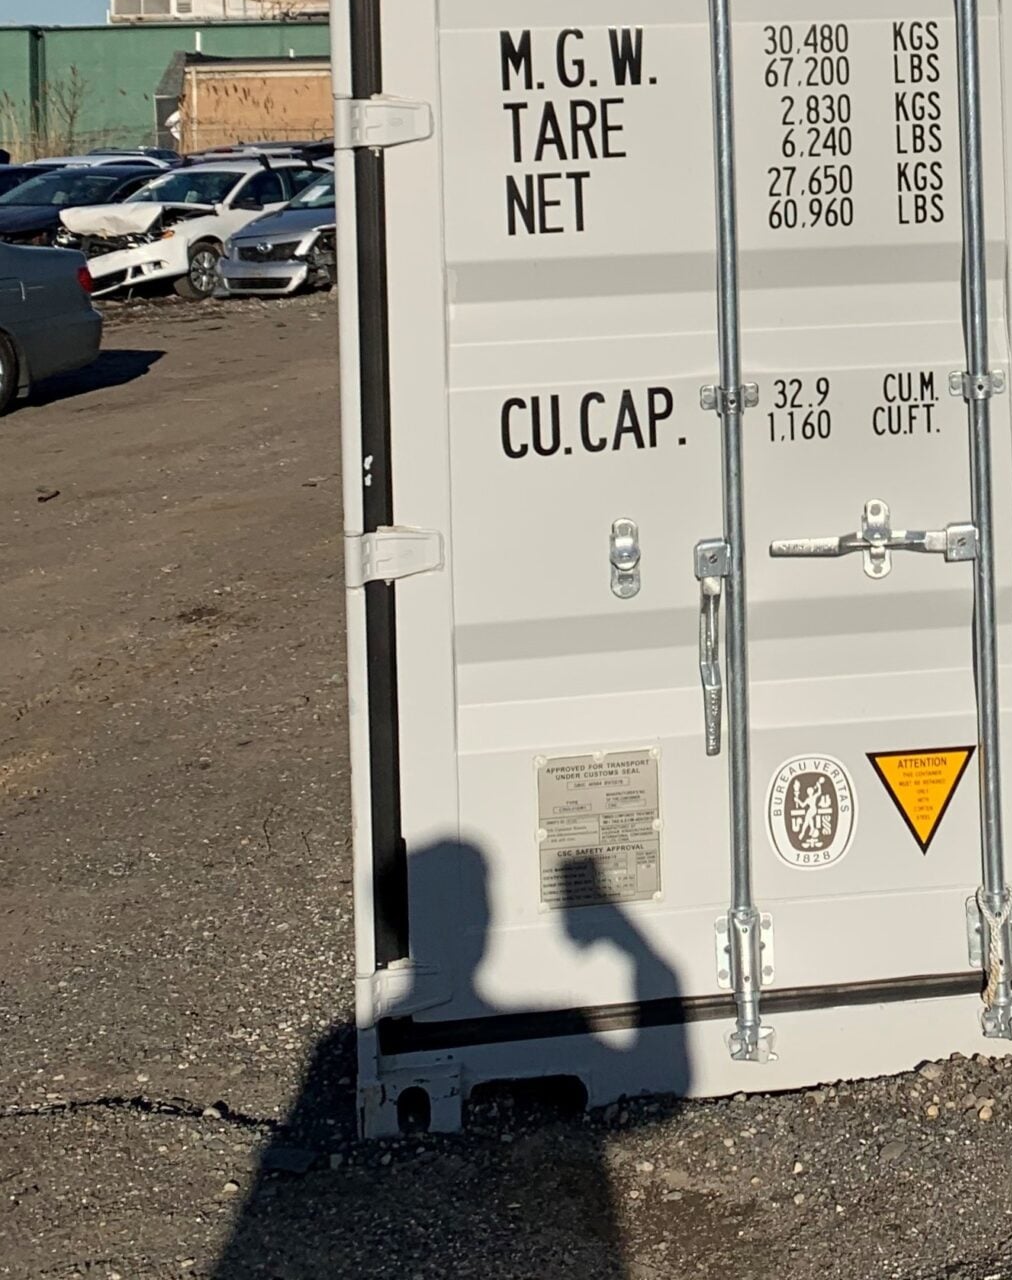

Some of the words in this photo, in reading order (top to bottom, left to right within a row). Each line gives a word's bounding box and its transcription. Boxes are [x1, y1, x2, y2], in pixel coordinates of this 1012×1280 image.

[499, 26, 657, 90] M.G.W.
[892, 21, 939, 51] KGS
[893, 54, 940, 84] LBS
[503, 97, 627, 162] TARE
[894, 91, 941, 121] KGS
[895, 123, 942, 154] LBS
[505, 170, 591, 236] NET
[897, 162, 944, 192] KGS
[898, 193, 945, 224] LBS
[501, 387, 687, 459] CU.CAP.
[773, 377, 830, 410] 32.9
[883, 371, 939, 403] CU.M.
[872, 403, 941, 436] CU.FT.
[546, 765, 585, 773] APPROVED
[607, 759, 649, 768] TRANSPORT
[584, 770, 618, 778] CUSTOMS
[897, 757, 947, 768] ATTENTION
[773, 761, 806, 817] BUREAU
[813, 761, 849, 813] VERITAS
[607, 844, 644, 852] APPROVAL
[796, 851, 830, 862] 1828
